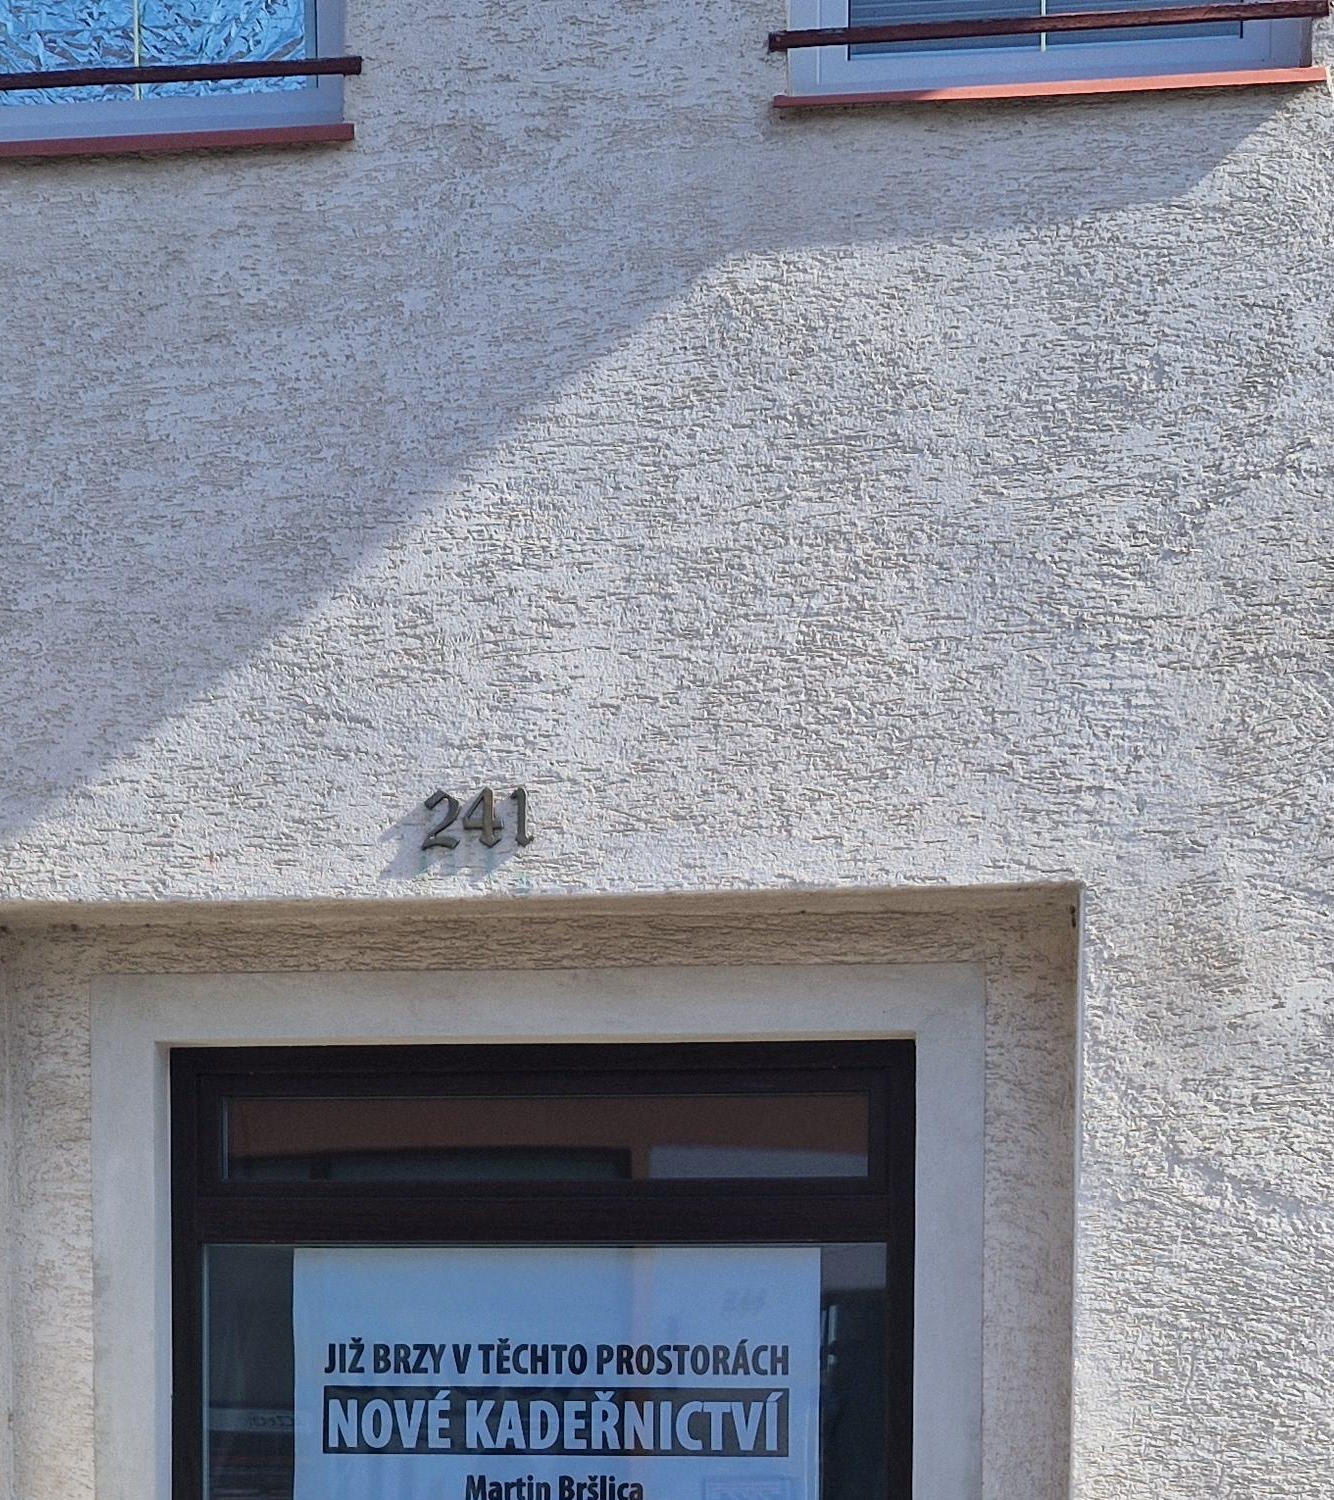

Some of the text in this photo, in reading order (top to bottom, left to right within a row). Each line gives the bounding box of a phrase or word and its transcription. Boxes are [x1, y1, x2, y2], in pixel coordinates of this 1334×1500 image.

[422, 787, 534, 850] 241
[324, 1337, 789, 1376] JIŽ BRZY V TĚCHTO PROSTORÁCH
[328, 1390, 784, 1451] NOVÉ KADEŘNICTVÍ
